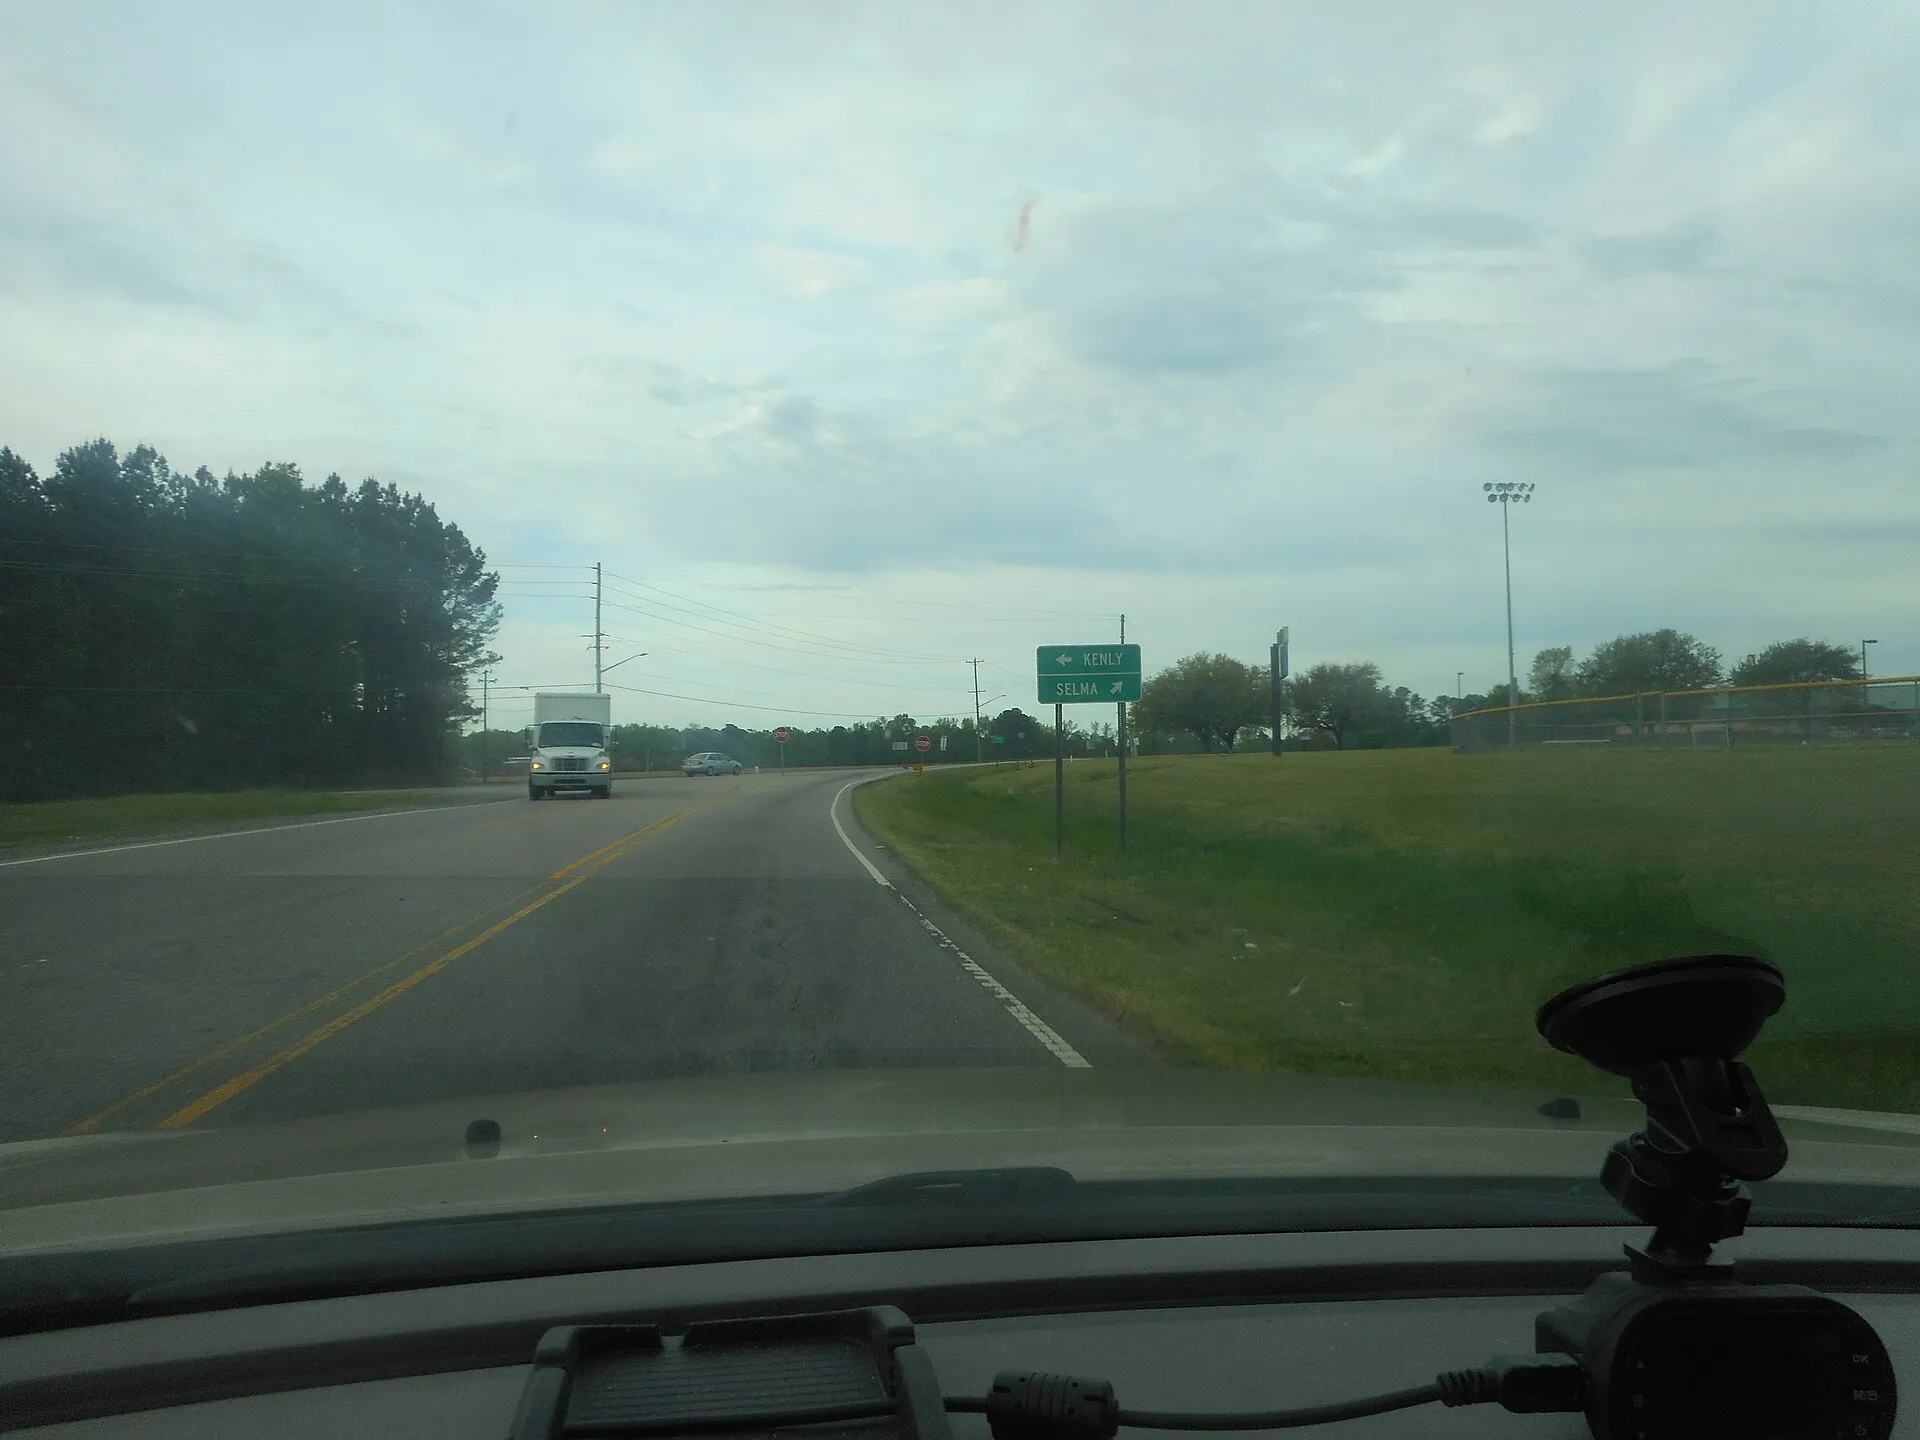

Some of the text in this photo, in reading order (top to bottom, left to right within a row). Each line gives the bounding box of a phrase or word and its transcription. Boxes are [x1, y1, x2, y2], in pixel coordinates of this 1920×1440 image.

[1084, 652, 1123, 666] KENLY
[1056, 682, 1098, 696] SELMA
[1852, 1353, 1869, 1364] OK
